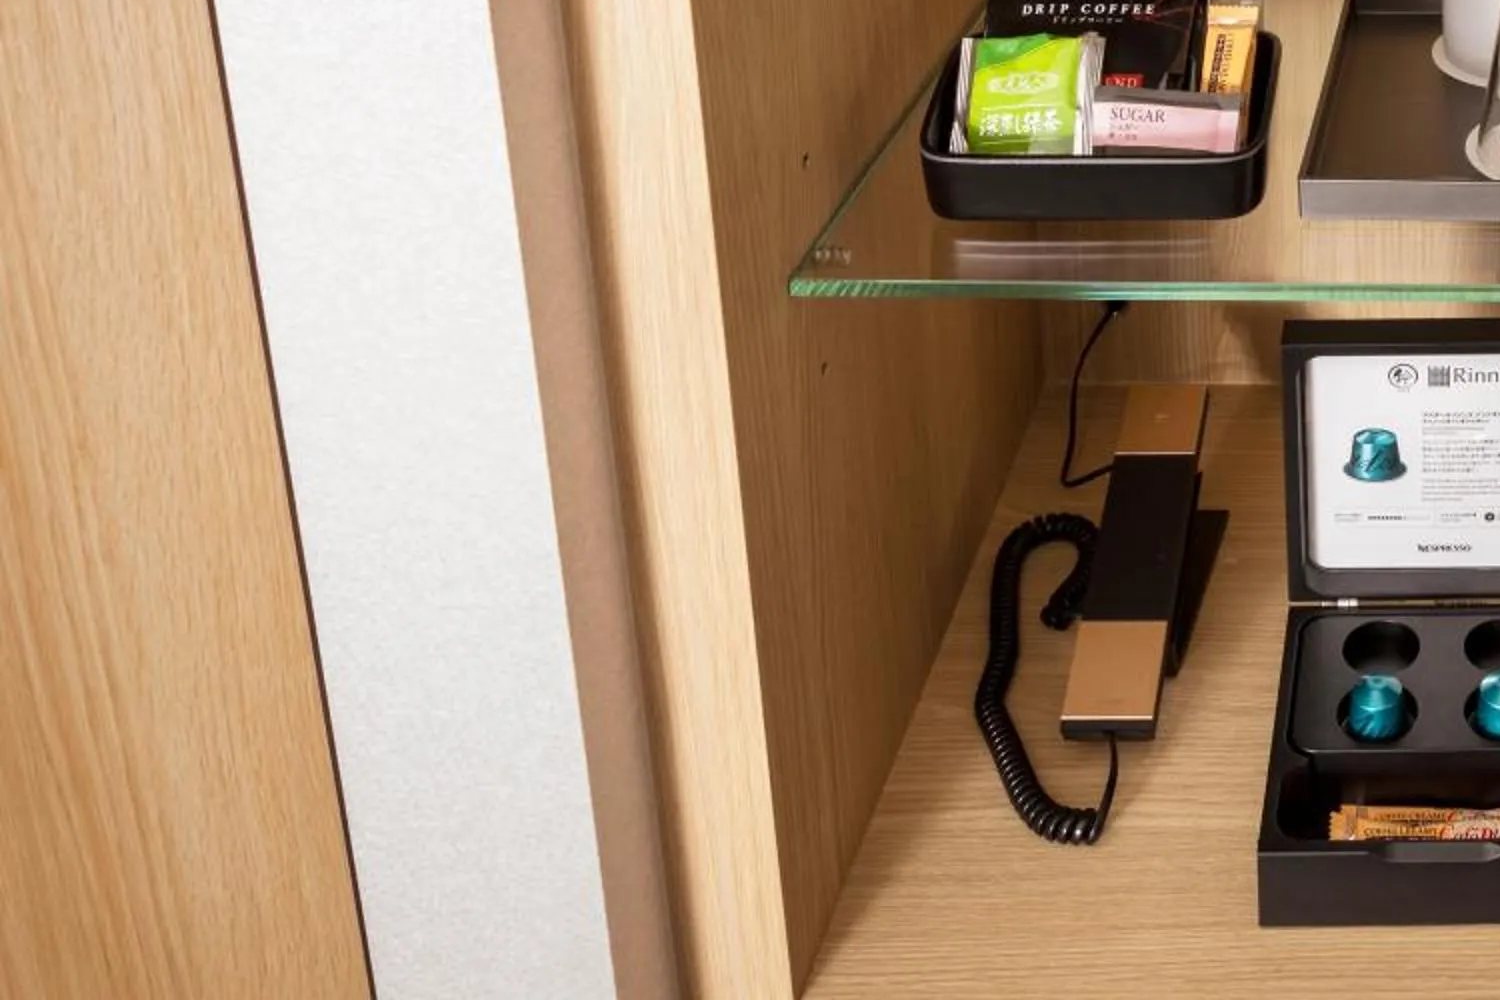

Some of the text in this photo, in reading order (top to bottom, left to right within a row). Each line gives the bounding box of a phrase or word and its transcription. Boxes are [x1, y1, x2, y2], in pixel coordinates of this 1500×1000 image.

[1022, 3, 1155, 15] DRIP COFFEE
[1110, 107, 1165, 123] SUGAR
[1453, 366, 1500, 384] Rinn
